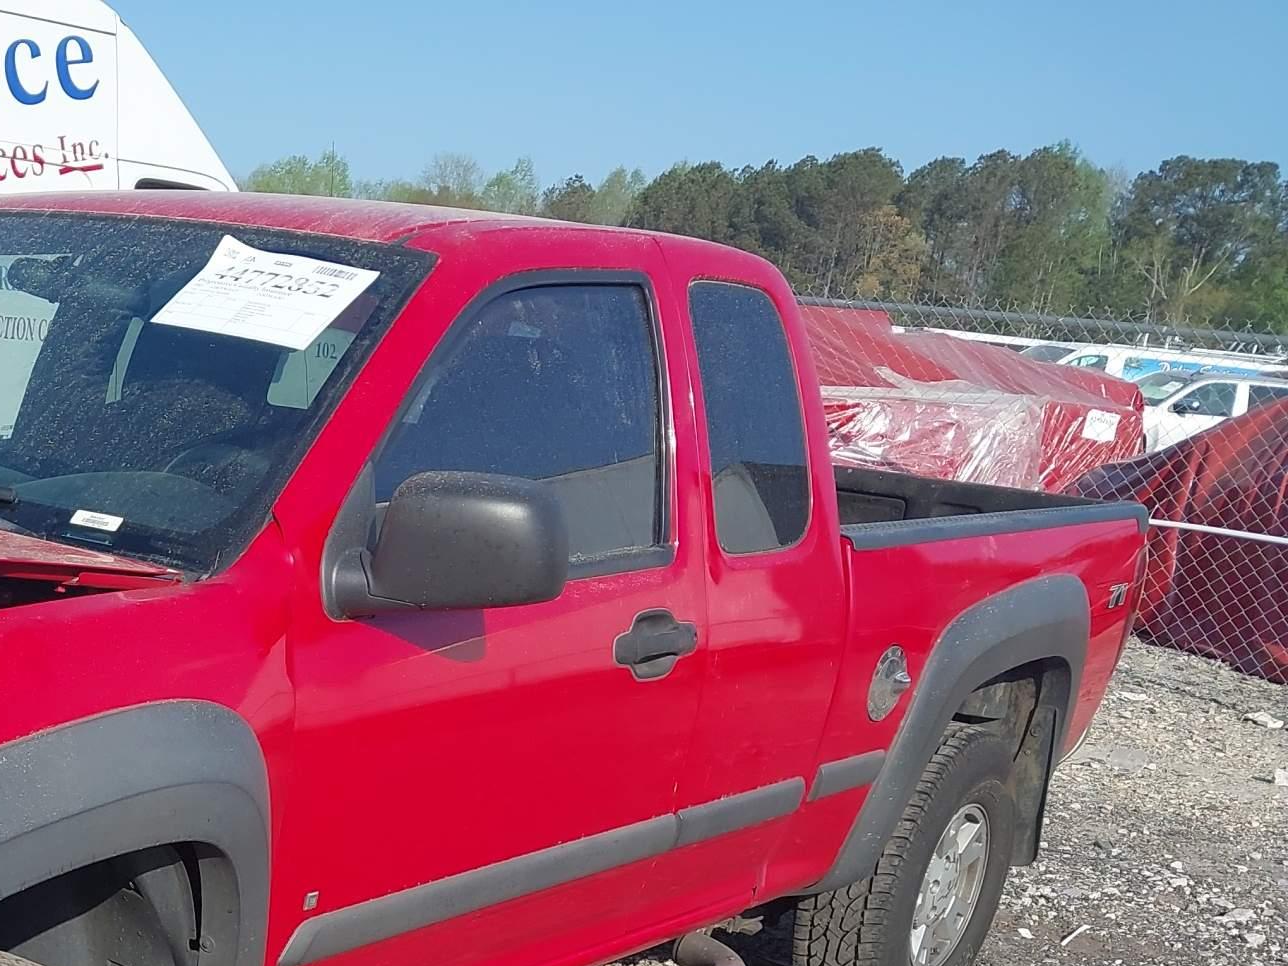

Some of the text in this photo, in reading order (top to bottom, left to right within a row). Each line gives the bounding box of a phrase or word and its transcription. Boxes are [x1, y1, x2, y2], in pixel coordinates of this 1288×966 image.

[57, 135, 109, 163] Inc.
[215, 266, 340, 298] 44772852
[312, 342, 337, 360] 102
